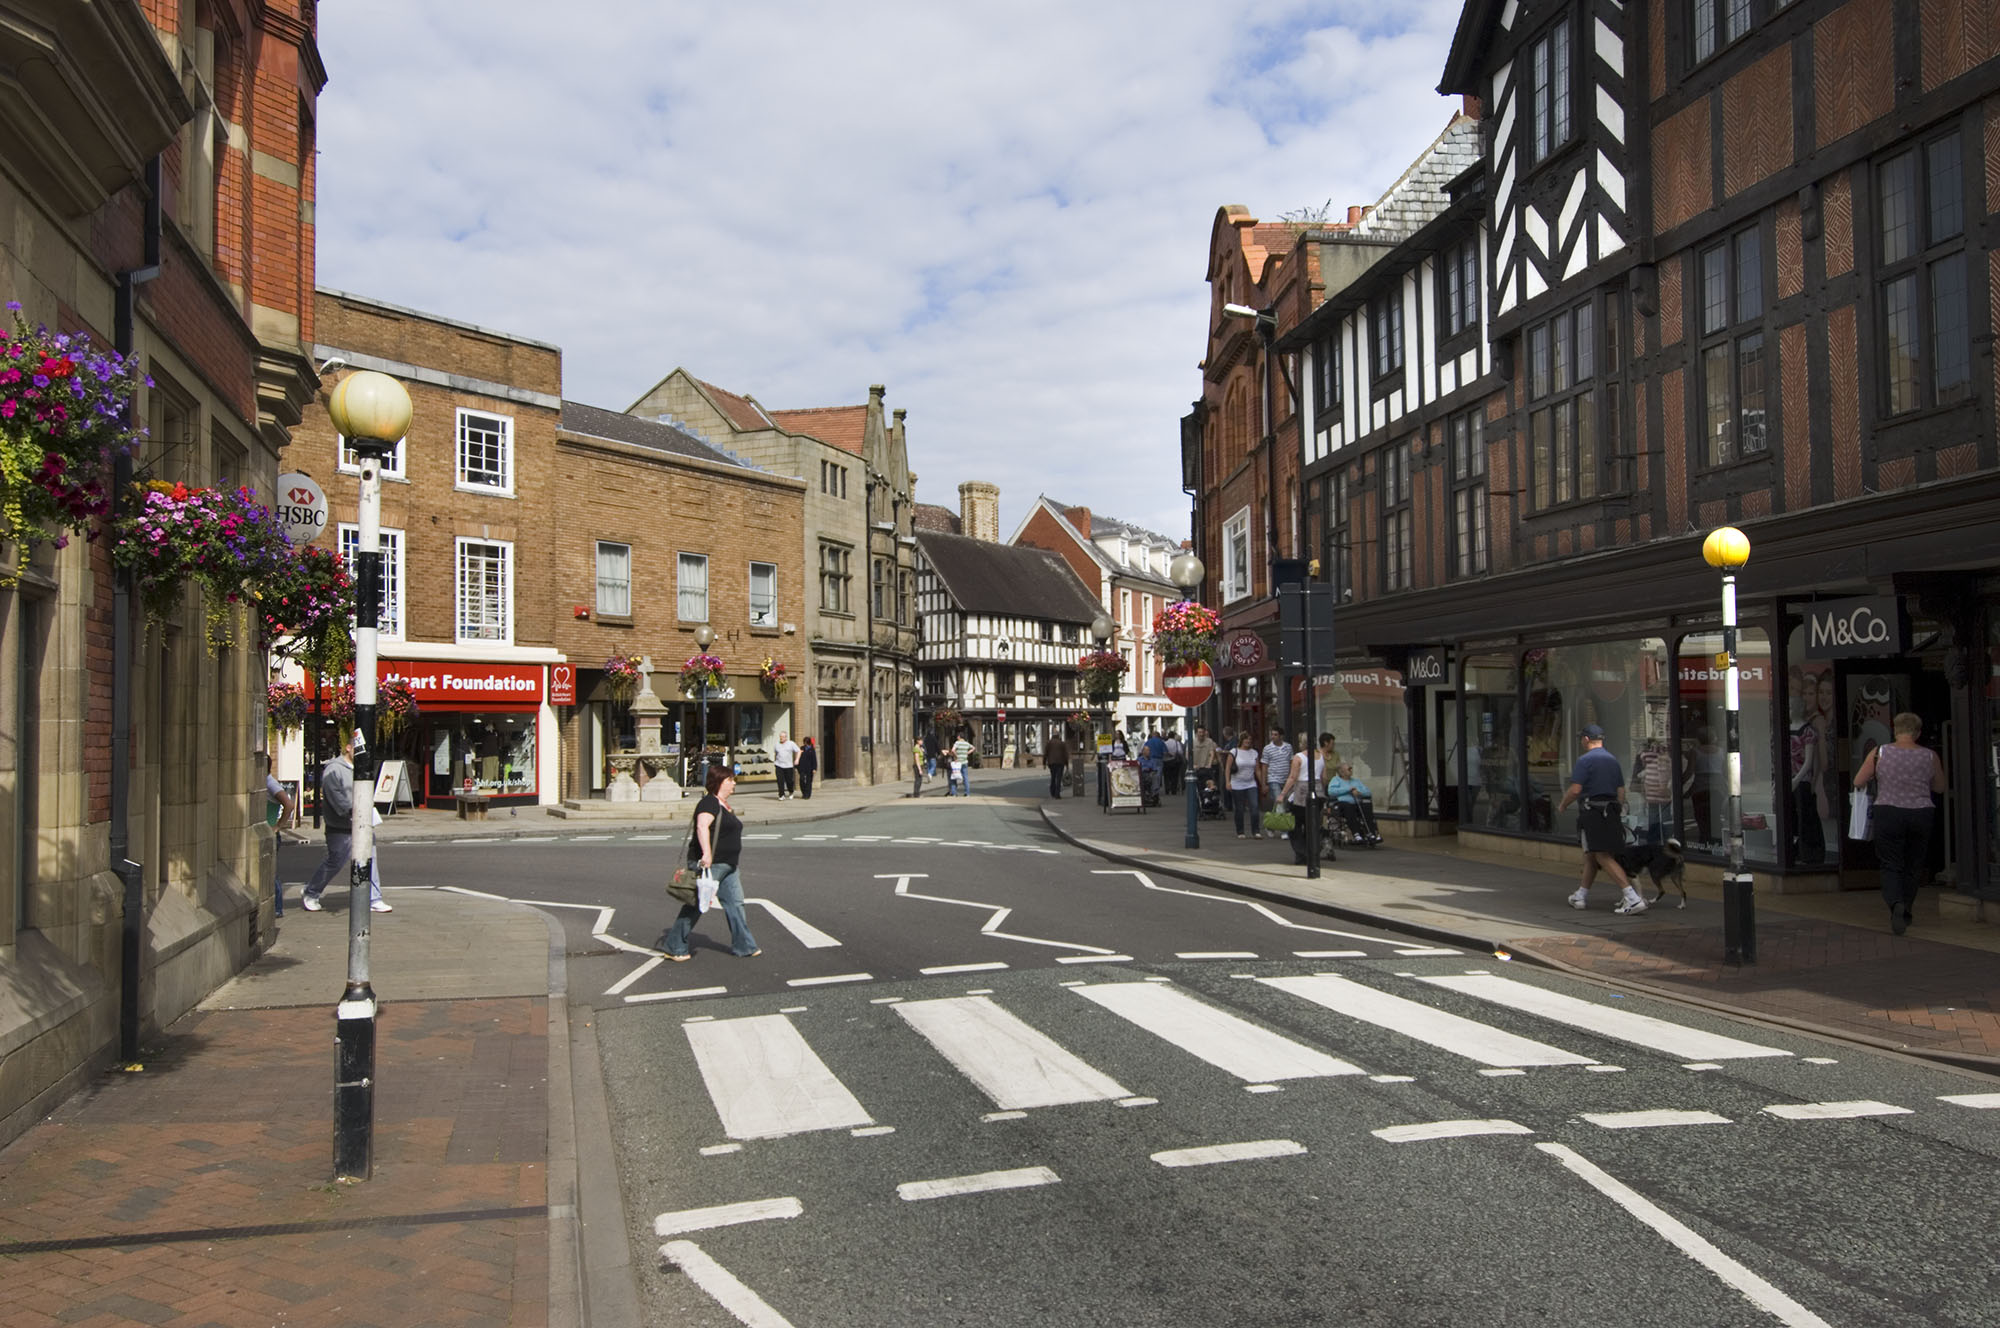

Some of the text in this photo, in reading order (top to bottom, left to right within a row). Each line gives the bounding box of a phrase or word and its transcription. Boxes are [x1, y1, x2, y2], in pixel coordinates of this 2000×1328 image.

[277, 505, 325, 527] HSBC
[1811, 607, 1890, 648] M&Co.
[1235, 637, 1257, 647] COSTA
[1234, 653, 1259, 664] COFFEE
[1409, 655, 1441, 679] M&Co.
[442, 674, 536, 691] Foundation
